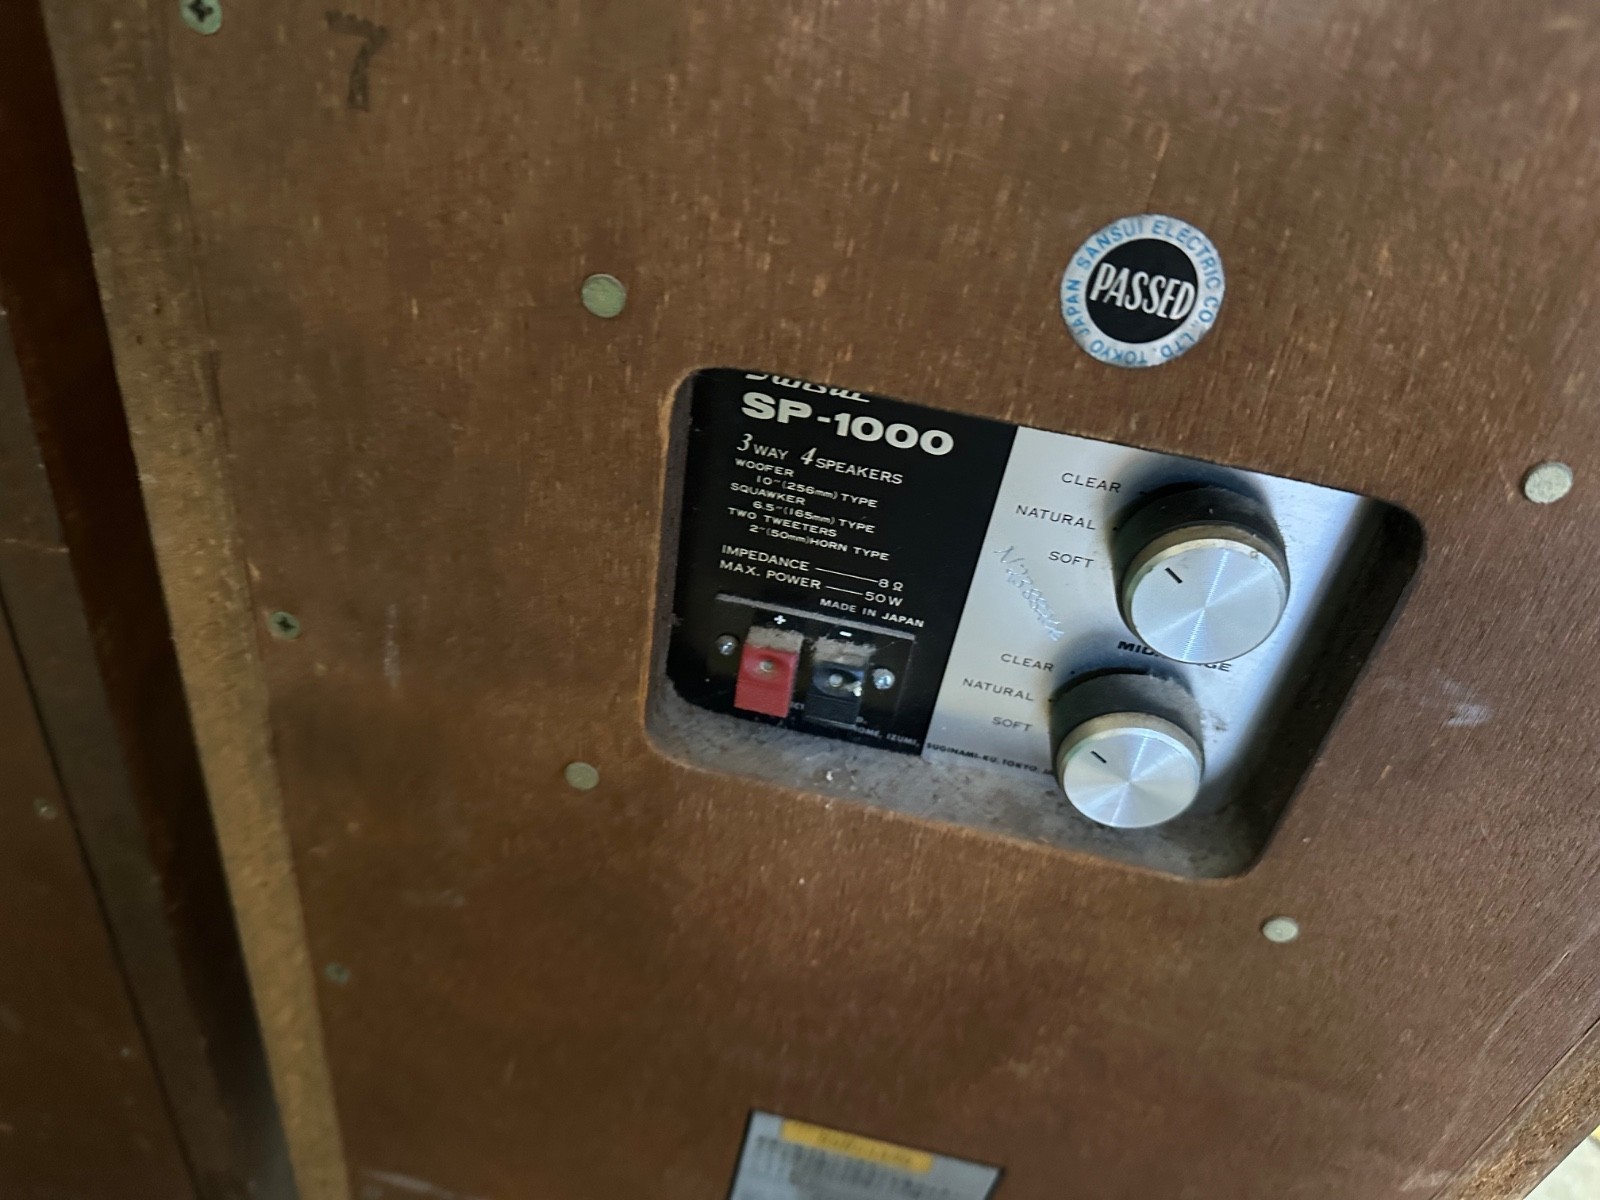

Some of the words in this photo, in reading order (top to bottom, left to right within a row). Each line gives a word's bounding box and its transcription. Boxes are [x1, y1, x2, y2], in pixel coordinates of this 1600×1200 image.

[324, 9, 391, 113] 7
[1075, 218, 1144, 269] SANSUI
[1152, 219, 1221, 289] ELECTRIC
[1089, 262, 1196, 321] PASSED
[1065, 278, 1090, 337] JAPAN
[1089, 339, 1147, 365] TOKYO
[734, 457, 795, 478] WOOFER
[753, 444, 789, 461] WAY
[815, 456, 904, 486] SPEAKERS
[730, 482, 807, 506] SQUAWKER
[1059, 471, 1122, 495] CLEAR
[840, 493, 879, 509] TYPE
[727, 506, 757, 521] TWO
[763, 514, 838, 537] TWEETERS
[838, 517, 876, 534] TYPE
[1014, 503, 1098, 531] NATURAL
[720, 544, 811, 573] IMPEDANCE
[852, 545, 892, 561] TYPE
[1047, 550, 1096, 569] SOFT
[719, 559, 761, 577] MAX.
[765, 569, 822, 590] POWER
[819, 597, 857, 613] MADE
[862, 607, 877, 617] IN
[880, 612, 925, 628] JAPAN
[999, 652, 1056, 673] CLEAR
[961, 676, 1036, 702] NATURAL
[991, 715, 1035, 733] SOFT
